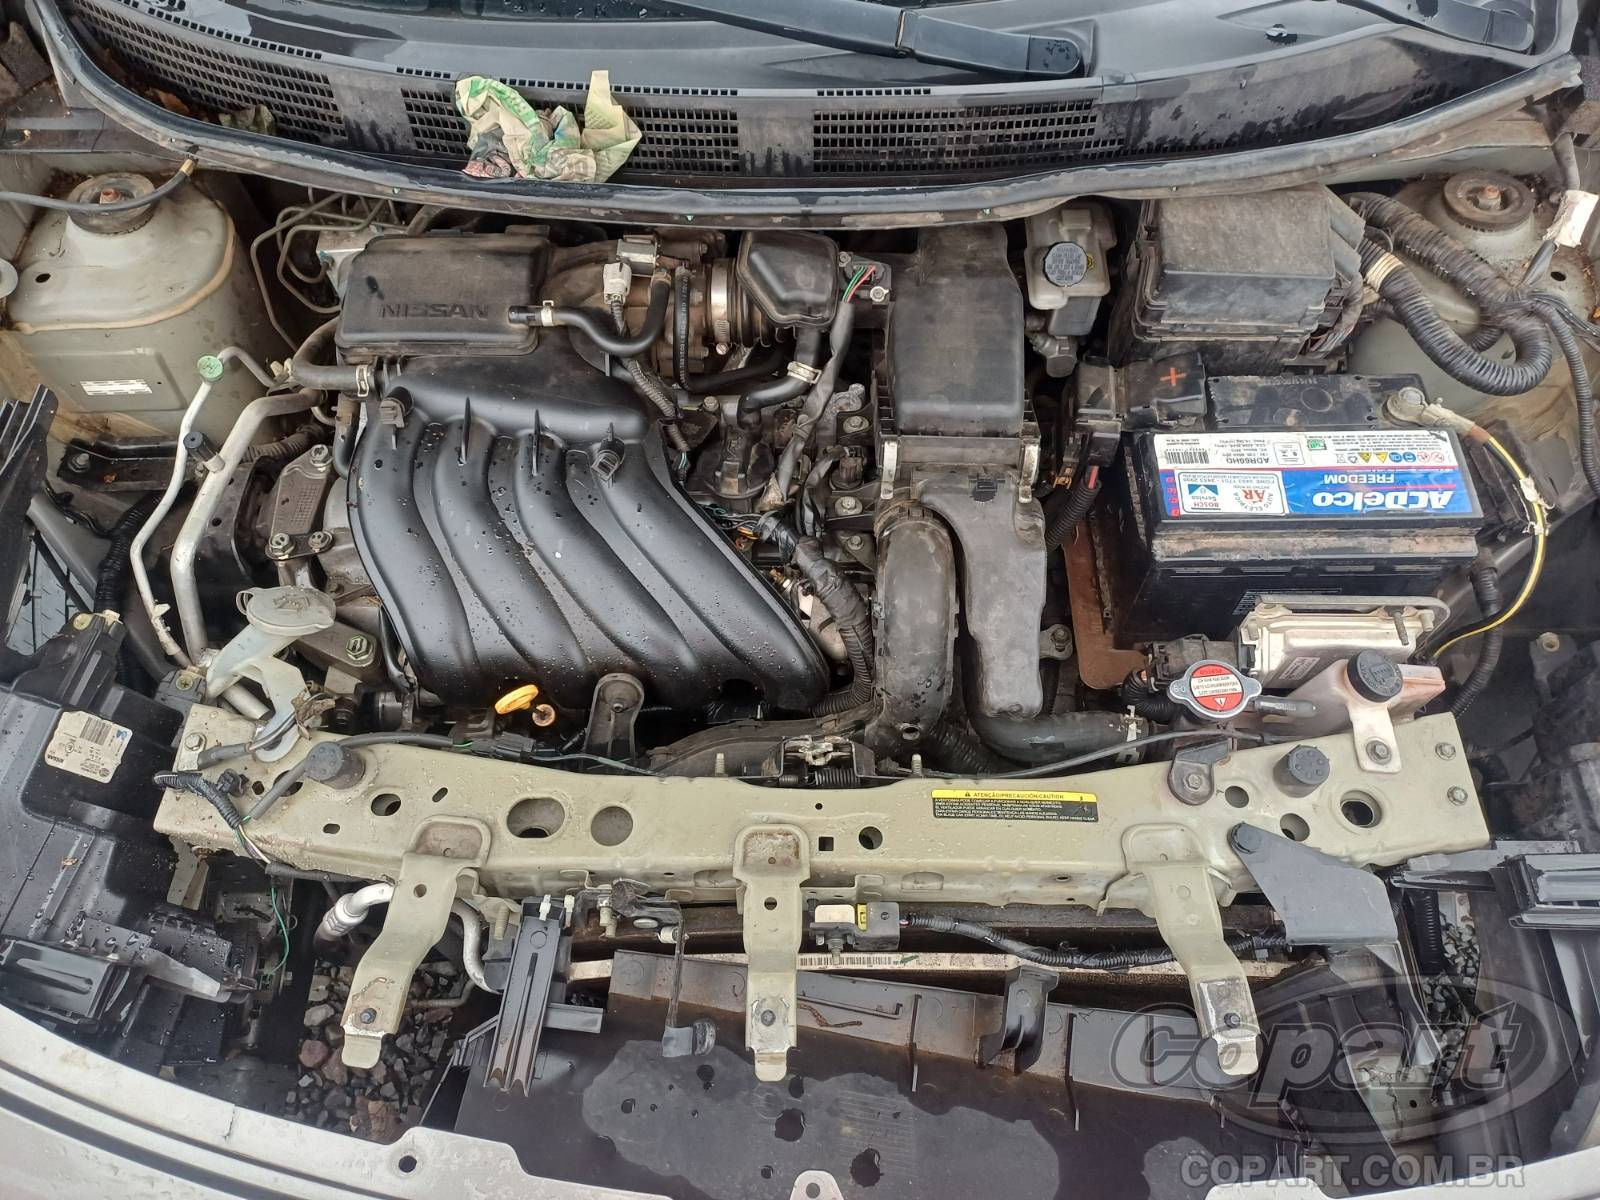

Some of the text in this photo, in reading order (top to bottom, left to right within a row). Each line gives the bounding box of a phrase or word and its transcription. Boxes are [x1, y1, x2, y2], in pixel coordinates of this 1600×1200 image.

[381, 303, 489, 319] NISSAN
[1323, 473, 1394, 484] FREEDOM
[1312, 490, 1455, 511] ACDelco
